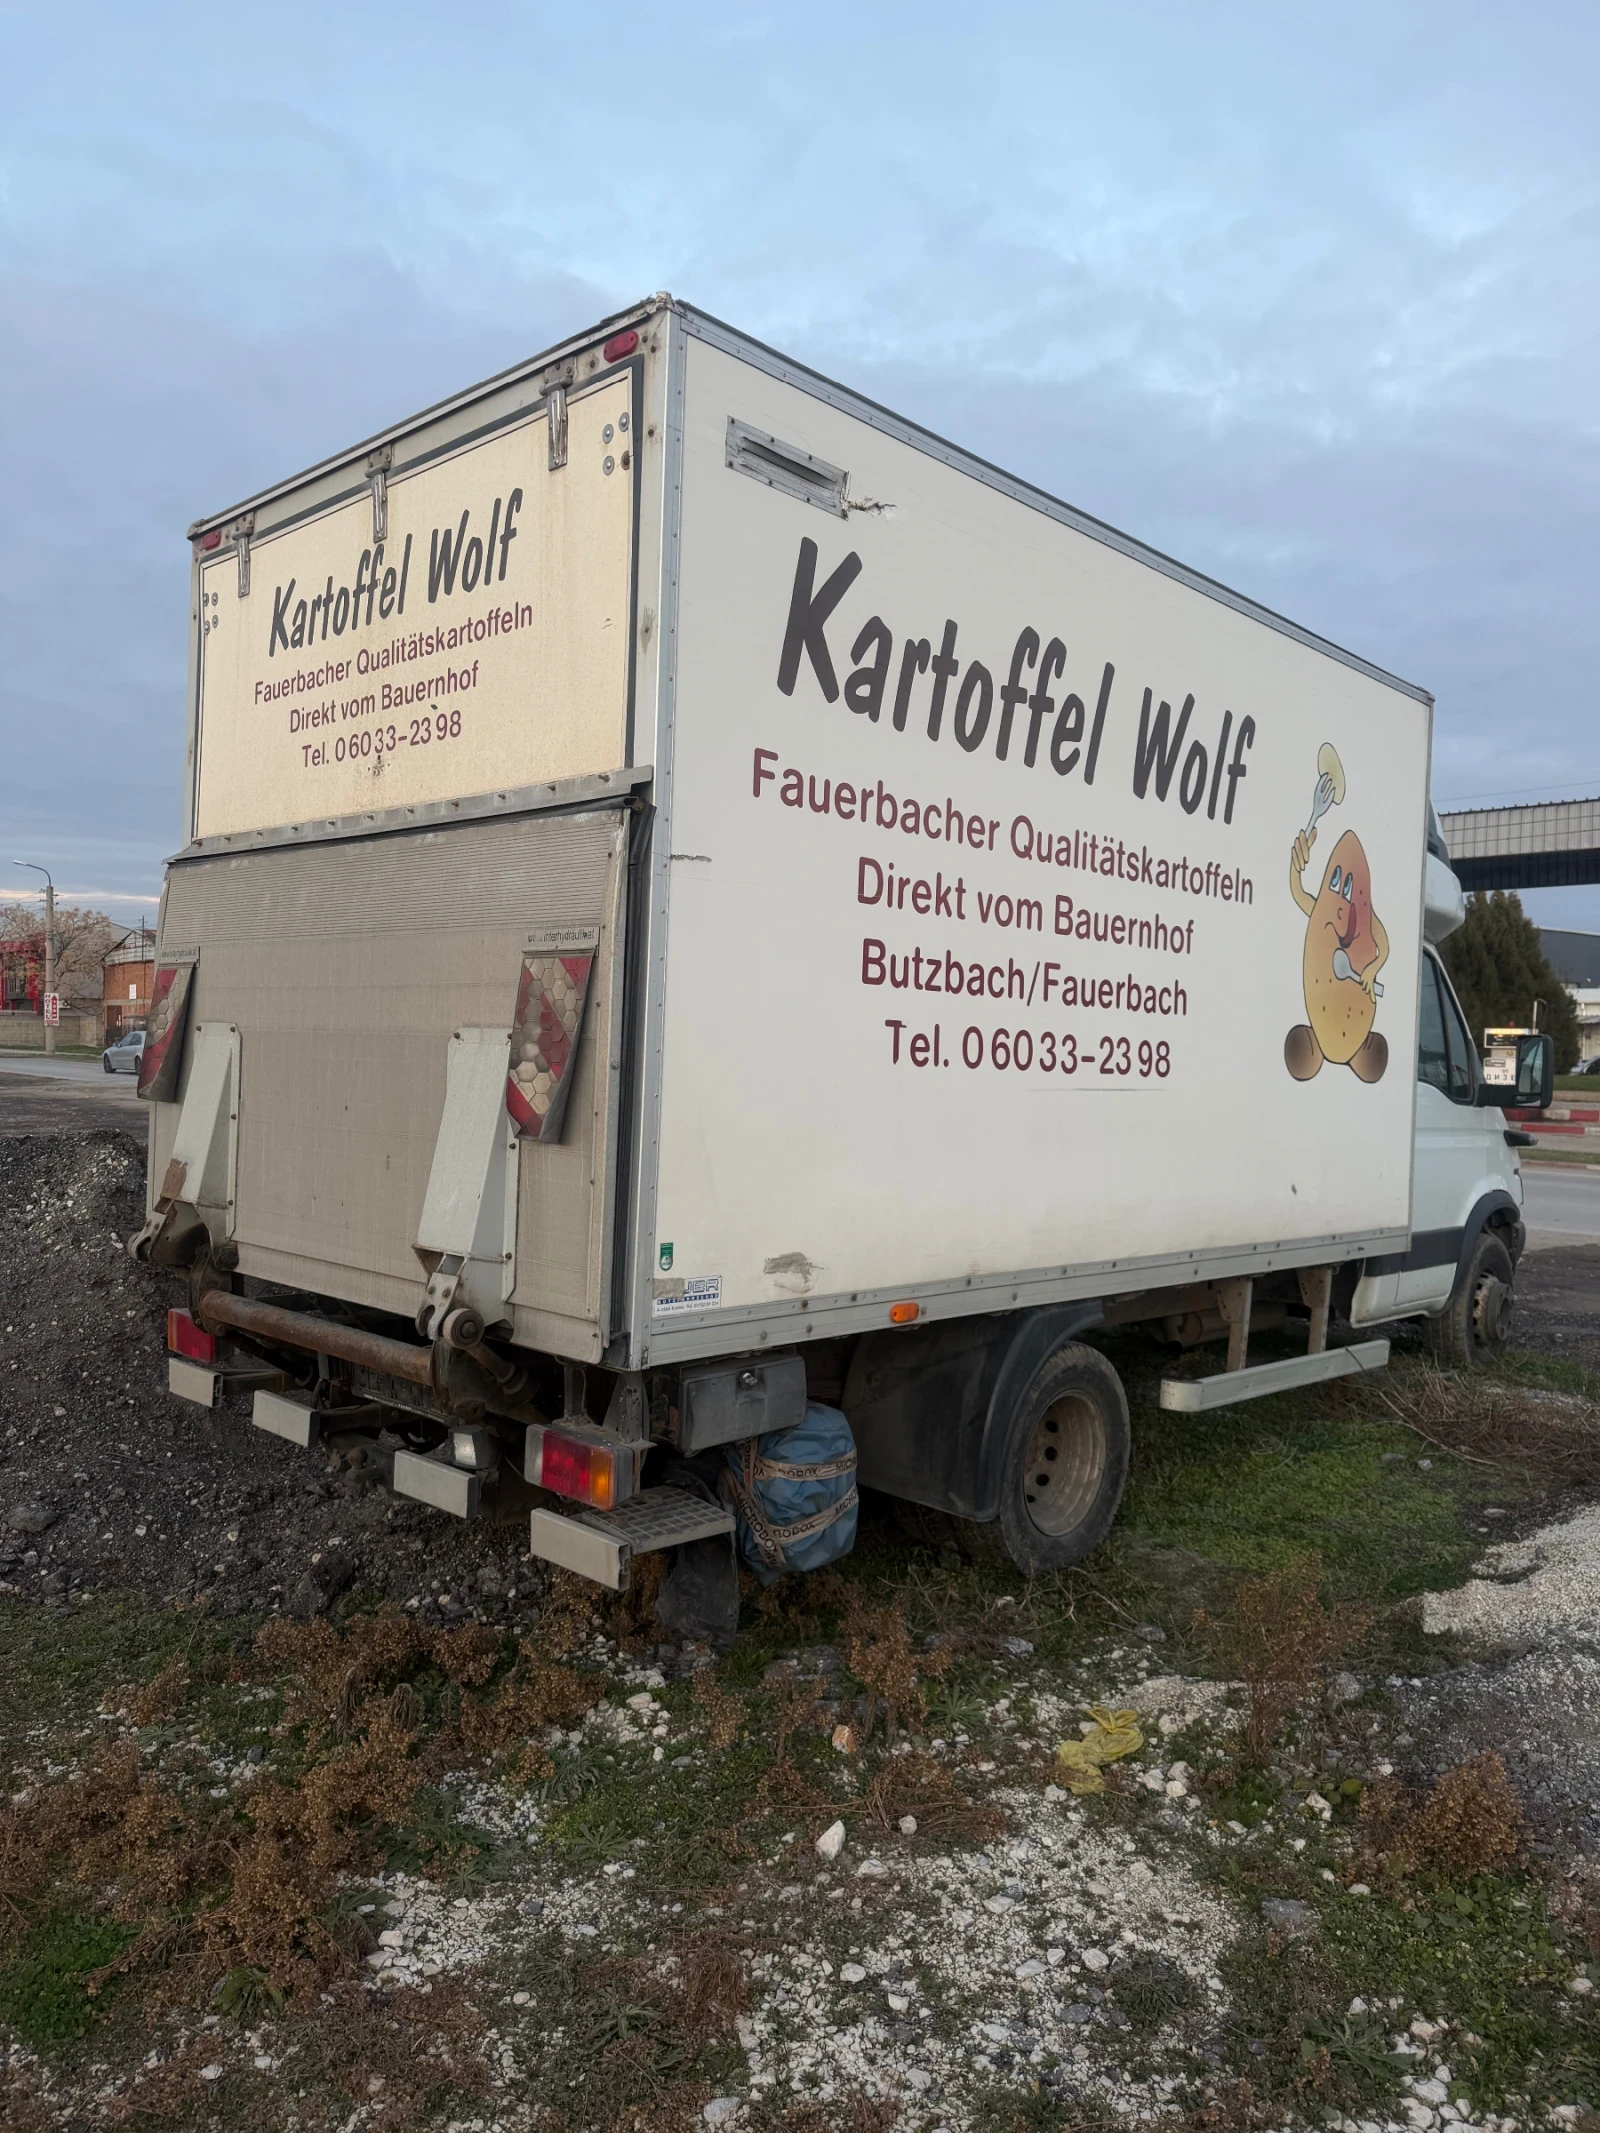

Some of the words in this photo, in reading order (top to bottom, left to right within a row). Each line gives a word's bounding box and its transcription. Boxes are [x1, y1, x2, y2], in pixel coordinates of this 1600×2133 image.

[269, 533, 412, 657] Kartoffel
[428, 488, 523, 603] Wolf
[254, 659, 352, 705] Fauerbacher
[356, 602, 533, 676] Qualitätskartoffeln
[290, 700, 337, 733] Direkt
[340, 695, 376, 721] vom
[382, 660, 480, 711] Bauernhof
[777, 537, 1115, 786] Kartoffel
[1133, 687, 1256, 825] Wolf
[302, 741, 330, 767] Tel.
[753, 748, 1001, 851] Fauerbacher
[1010, 815, 1253, 905] Qualitätskartoffeln
[858, 857, 967, 921] Direkt
[977, 891, 1043, 932] vom
[1054, 895, 1195, 955] Bauernhof
[862, 938, 1188, 1017] Butzbach/Fauerbach
[885, 1020, 950, 1068] Tel.
